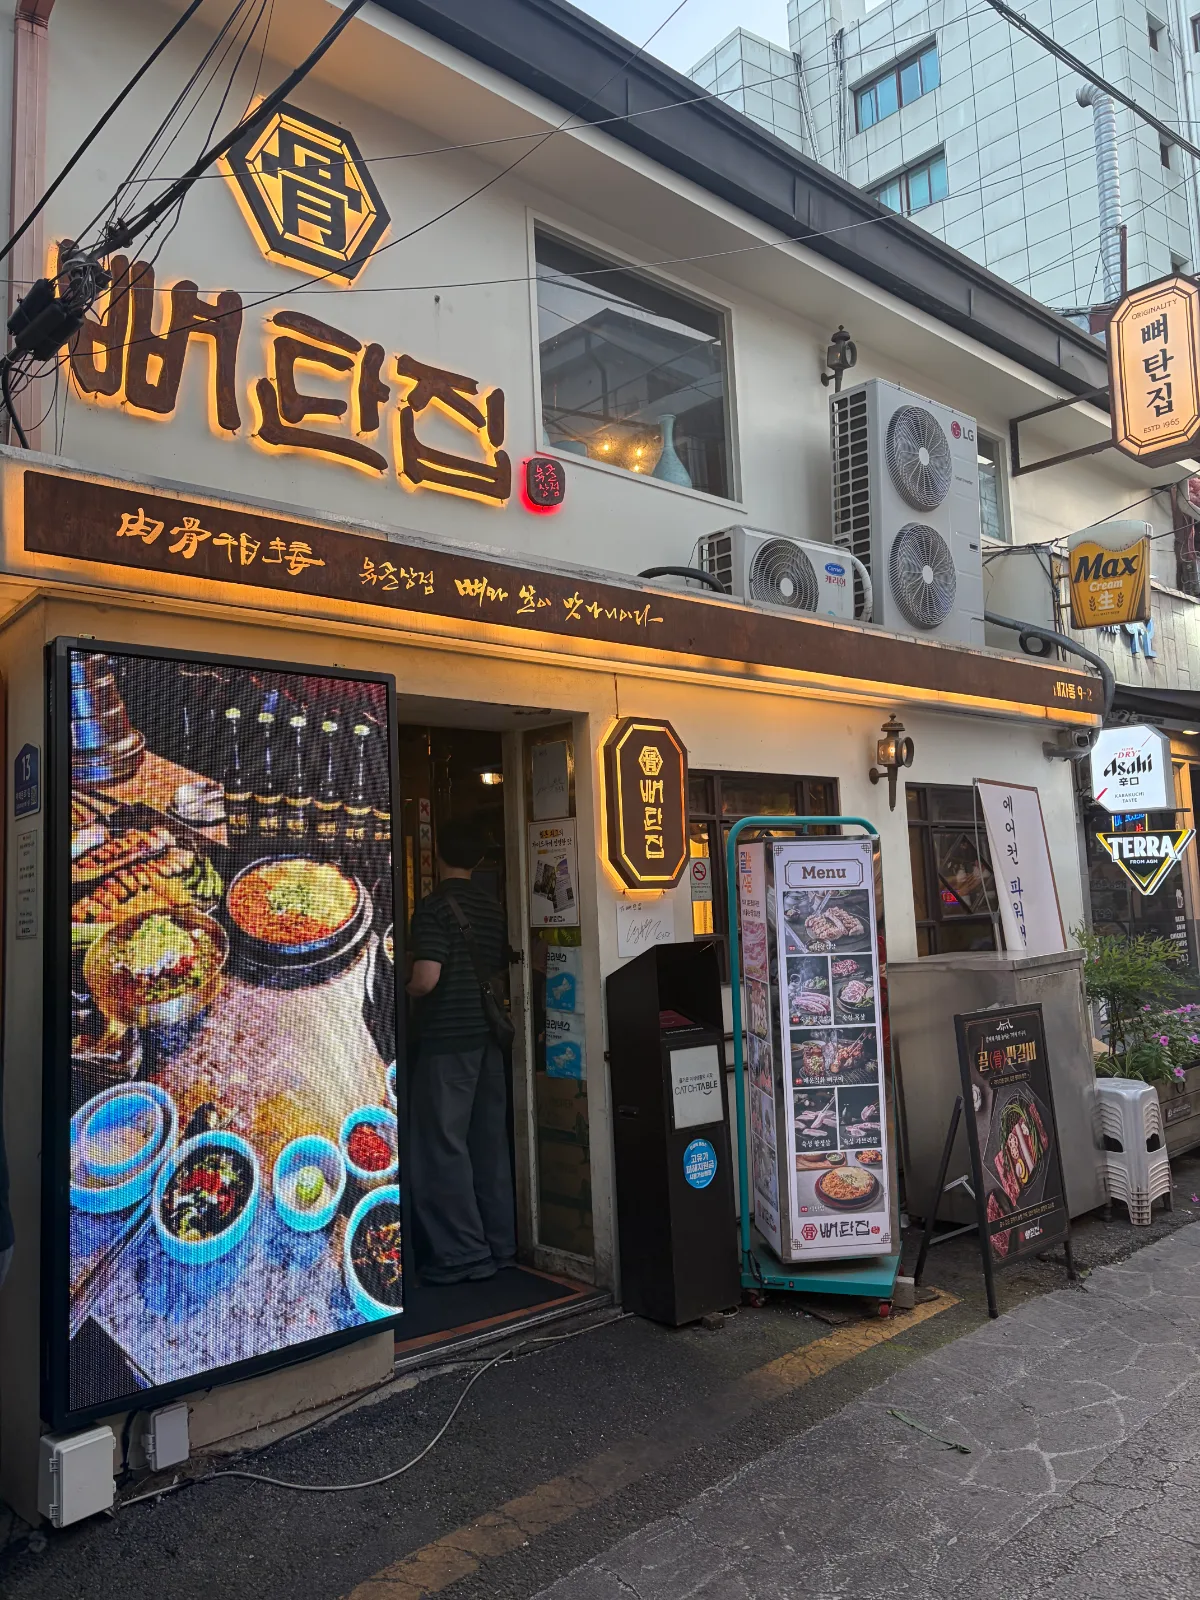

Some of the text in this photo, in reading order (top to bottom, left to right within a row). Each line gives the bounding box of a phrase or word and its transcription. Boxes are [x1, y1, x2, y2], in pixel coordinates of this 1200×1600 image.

[1131, 298, 1178, 320] ORIGINALITY
[1140, 313, 1175, 418] 뼈탄집
[1163, 417, 1180, 428] 1965
[962, 427, 974, 441] LG
[1073, 552, 1139, 584] Max
[825, 575, 846, 587] 캐리어
[1089, 580, 1123, 593] Cream
[1098, 590, 1115, 610] 生
[21, 753, 31, 781] 13
[1103, 753, 1152, 778] Asahi
[1118, 777, 1140, 787] 辛口
[639, 779, 665, 860] 뼈탄집
[1002, 795, 1018, 866] 에어컨
[1107, 835, 1178, 861] TERRA
[801, 865, 847, 880] Menu
[674, 1080, 718, 1096] CATCHTABLE
[691, 1152, 709, 1164] 고유가
[819, 1220, 870, 1239] 뼈탄집
